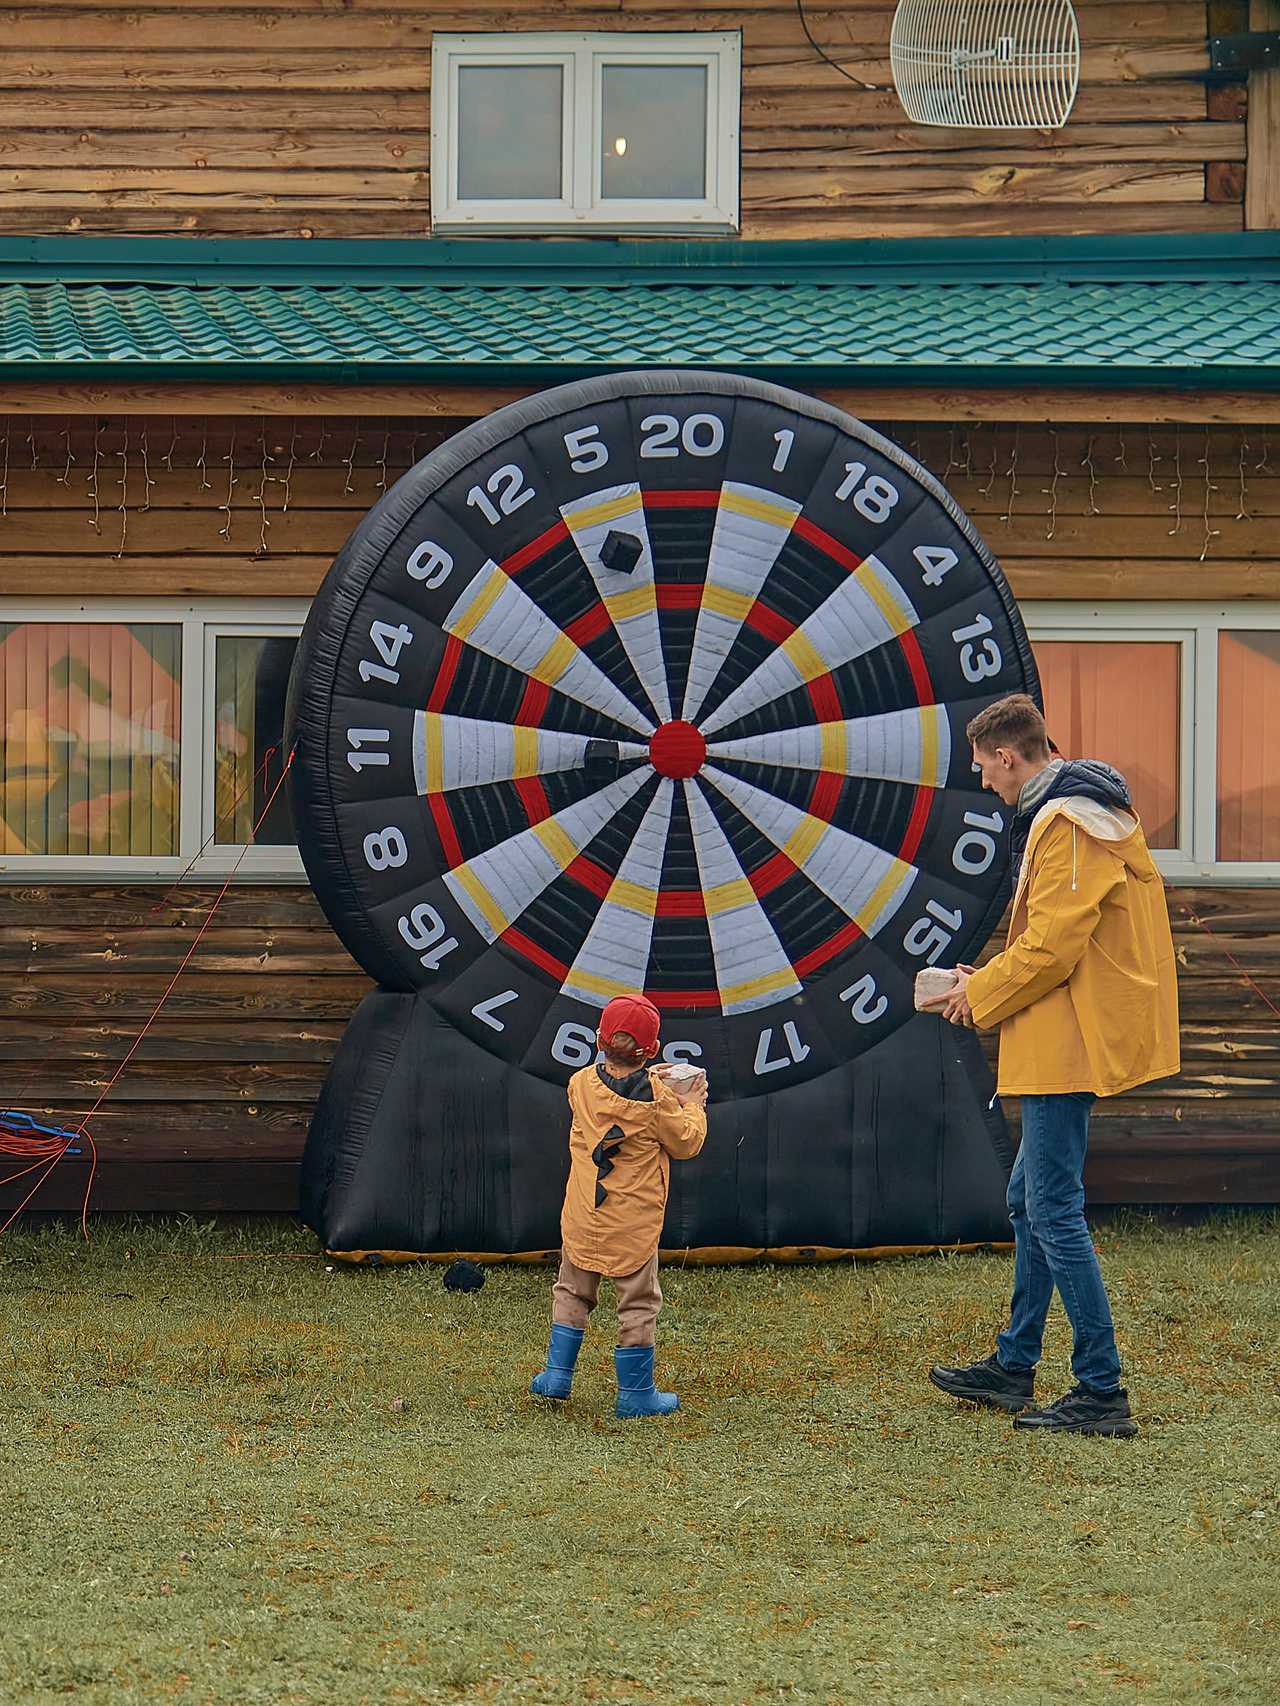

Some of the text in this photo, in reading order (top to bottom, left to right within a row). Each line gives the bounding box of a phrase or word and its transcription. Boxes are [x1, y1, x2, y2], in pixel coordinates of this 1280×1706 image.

[564, 425, 609, 473] 5
[640, 413, 725, 457] 20
[772, 428, 795, 472] 1
[466, 464, 536, 524] 12
[835, 461, 899, 523] 18
[406, 540, 454, 589] 9
[912, 545, 959, 586] 4
[358, 620, 413, 684] 14
[951, 613, 1002, 683] 13
[347, 728, 390, 772] 11
[363, 826, 409, 871] 8
[952, 811, 1004, 875] 10
[397, 903, 458, 970] 16
[903, 899, 962, 965] 15
[471, 990, 519, 1031] 7
[839, 974, 888, 1024] 2
[753, 1021, 810, 1075] 17
